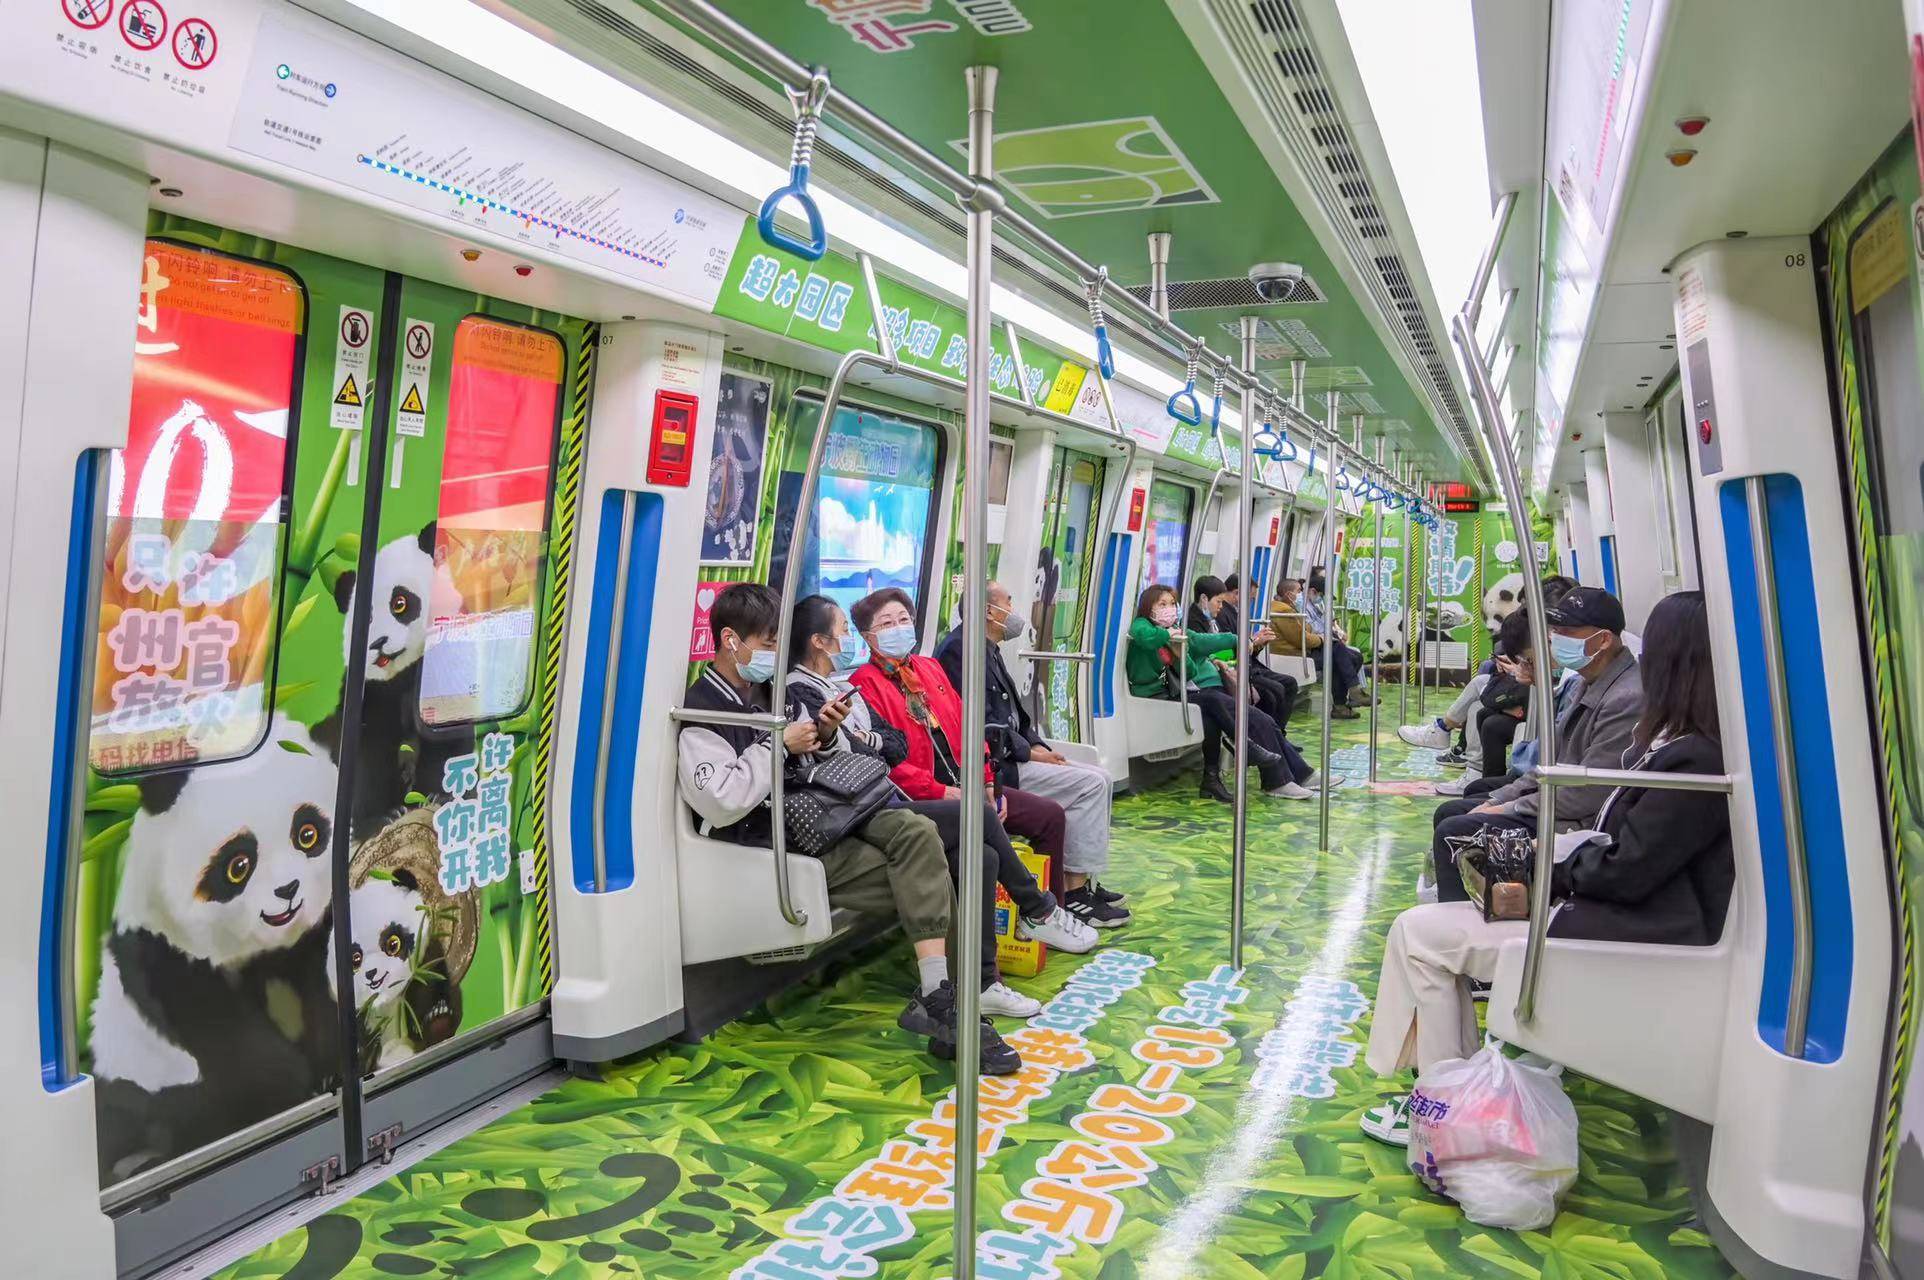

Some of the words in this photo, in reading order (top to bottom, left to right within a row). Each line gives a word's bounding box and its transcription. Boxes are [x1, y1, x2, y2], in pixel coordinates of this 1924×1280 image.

[1784, 253, 1806, 268] 08
[739, 254, 854, 332] 超大园区
[602, 335, 614, 345] 07
[1348, 556, 1397, 572] 202年
[107, 608, 239, 694] 州官
[442, 733, 514, 797] 不许
[434, 773, 511, 850] 你离
[438, 833, 510, 896] 开我
